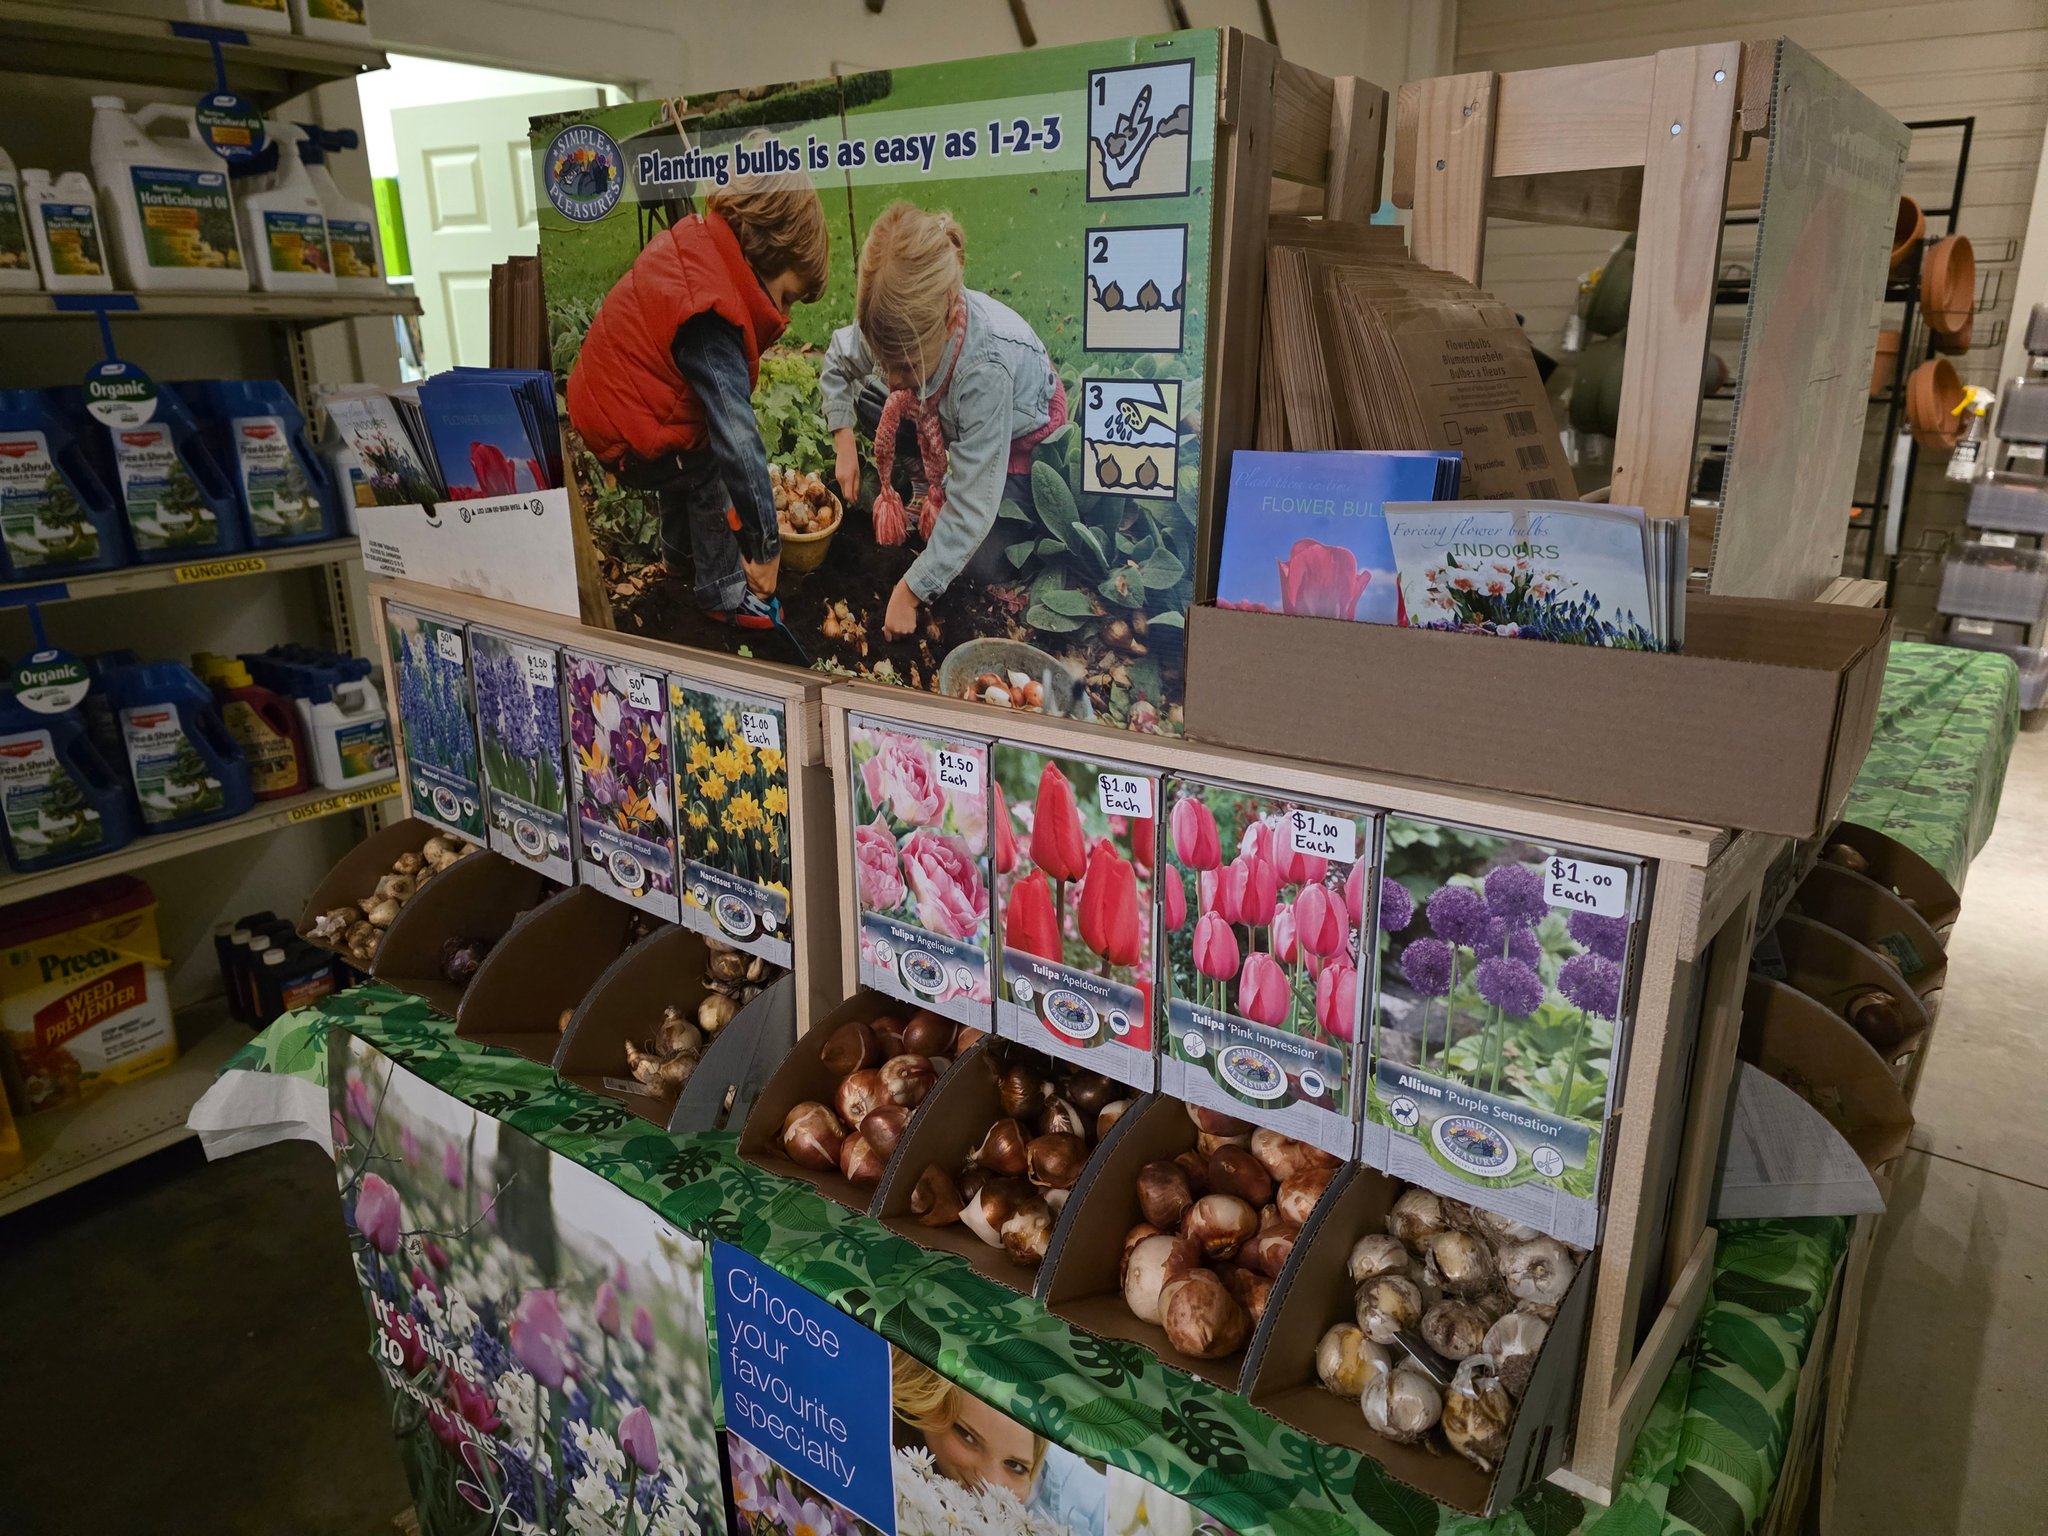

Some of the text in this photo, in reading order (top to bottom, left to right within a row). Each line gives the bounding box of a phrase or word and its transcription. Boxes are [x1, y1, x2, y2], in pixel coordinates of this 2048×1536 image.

[1094, 77, 1106, 106] 1
[198, 115, 247, 127] Horticultural
[557, 129, 605, 153] SIMPLE
[639, 116, 1061, 186] Planting bulbs is as easy as 1-2-3
[140, 191, 227, 208] Horticultural Oil
[550, 181, 620, 218] PLEASURES
[1093, 236, 1108, 263] 2
[1445, 338, 1491, 350] Flowerbulbs
[1442, 351, 1504, 365] Blumenzwiebeln
[1450, 368, 1475, 379] Bulbes
[90, 380, 147, 399] Organic
[1089, 385, 1103, 409] 3
[1464, 424, 1488, 436] Begonia
[146, 450, 174, 461] Shrub
[21, 461, 51, 473] Shrub
[1262, 496, 1335, 516] FLOWER
[1393, 515, 1552, 549] Forcing flower bulbs
[1453, 542, 1560, 560] INDOORS
[181, 559, 263, 580] FUNGICIDES
[441, 644, 457, 658] Each
[20, 664, 79, 686] Organic
[530, 668, 548, 681] Each
[630, 692, 651, 705] Each
[743, 714, 768, 730] $1.00
[153, 729, 181, 741] Shrub
[746, 731, 770, 745] Each
[25, 757, 56, 771] Shrub
[939, 752, 973, 773] $1.50
[940, 770, 968, 787] Each
[1100, 775, 1137, 794] $1.00
[292, 784, 397, 820] DISEASE CONTROL
[1105, 795, 1140, 813] Each
[1292, 811, 1338, 838] $1.00
[599, 830, 651, 855] Crocus giant mixed
[1295, 834, 1335, 854] Each
[700, 871, 731, 888] Narcissus
[1550, 857, 1612, 887] $1.00
[1553, 883, 1597, 907] Each
[891, 926, 956, 955] Tulipa 'Angelique'
[1032, 963, 1110, 997] Tulipa 'Apeldoorn'
[66, 980, 115, 1014] WEED
[1058, 992, 1085, 1007] SIMPLE
[46, 985, 136, 1042] PREVENTER
[1051, 1007, 1092, 1030] PLEASURES
[1192, 1012, 1318, 1060] Tulipa 'Pink Impression'
[1236, 1048, 1269, 1065] SIMPLE
[1228, 1065, 1277, 1090] PLEASURES
[1399, 1075, 1441, 1098] Allium
[1445, 1089, 1489, 1113] 'Purple
[1493, 1107, 1562, 1137] Sensation'
[1455, 1119, 1496, 1139] SIMPLE
[1444, 1136, 1504, 1166] PLEASURES
[728, 1268, 840, 1358] Choose
[370, 1290, 477, 1383] It's time
[377, 1327, 405, 1365] to
[727, 1313, 789, 1365] your
[384, 1365, 451, 1423] plant
[730, 1347, 847, 1443] favourite
[735, 1392, 856, 1488] specialty
